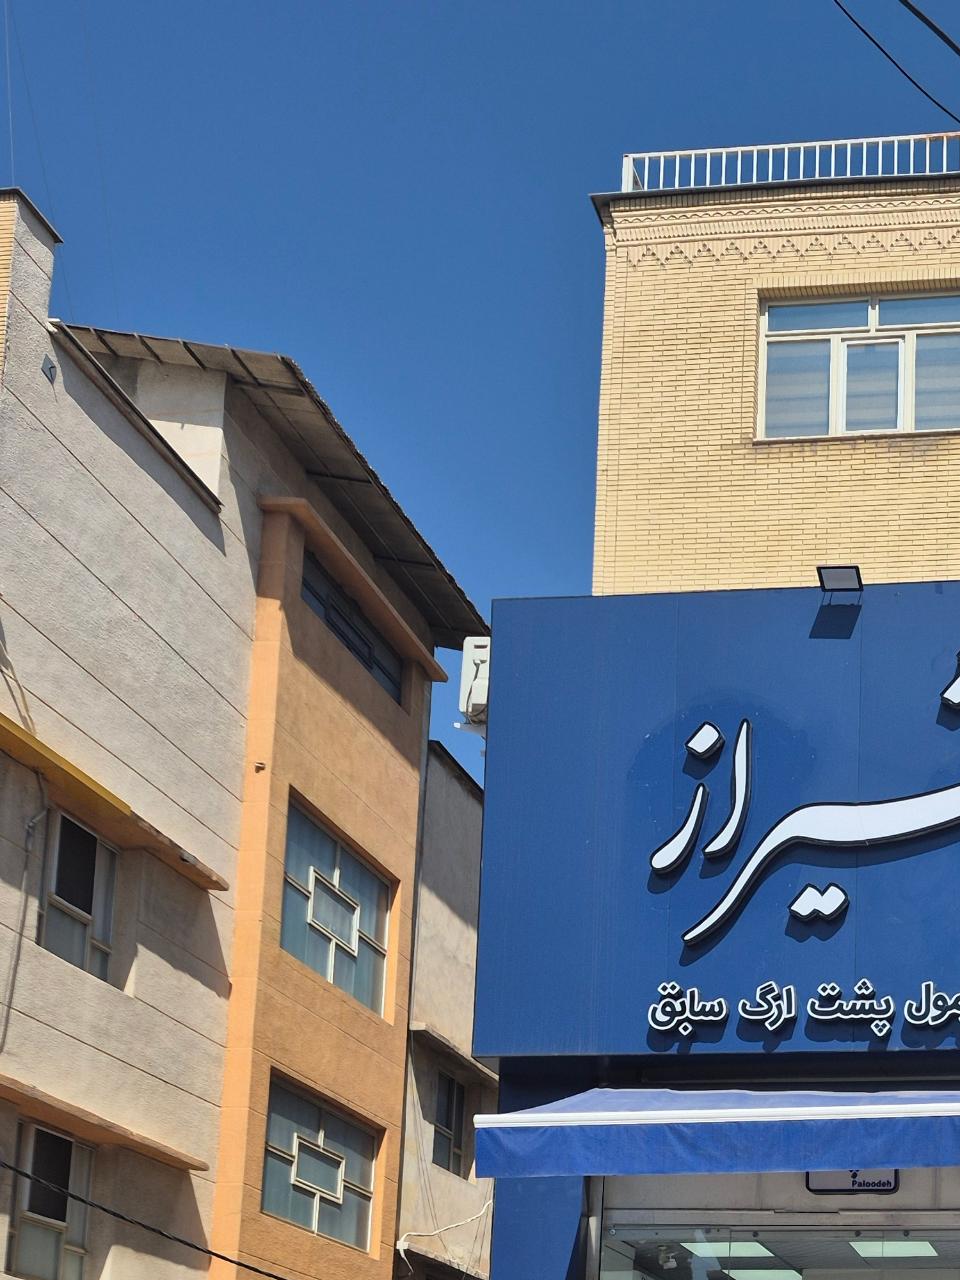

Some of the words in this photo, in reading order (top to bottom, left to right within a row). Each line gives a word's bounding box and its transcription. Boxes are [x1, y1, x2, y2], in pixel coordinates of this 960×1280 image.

[647, 981, 727, 1036] سابق
[737, 980, 795, 1030] ارگ
[806, 978, 894, 1037] پشت
[851, 1180, 892, 1188] Paloodeh
